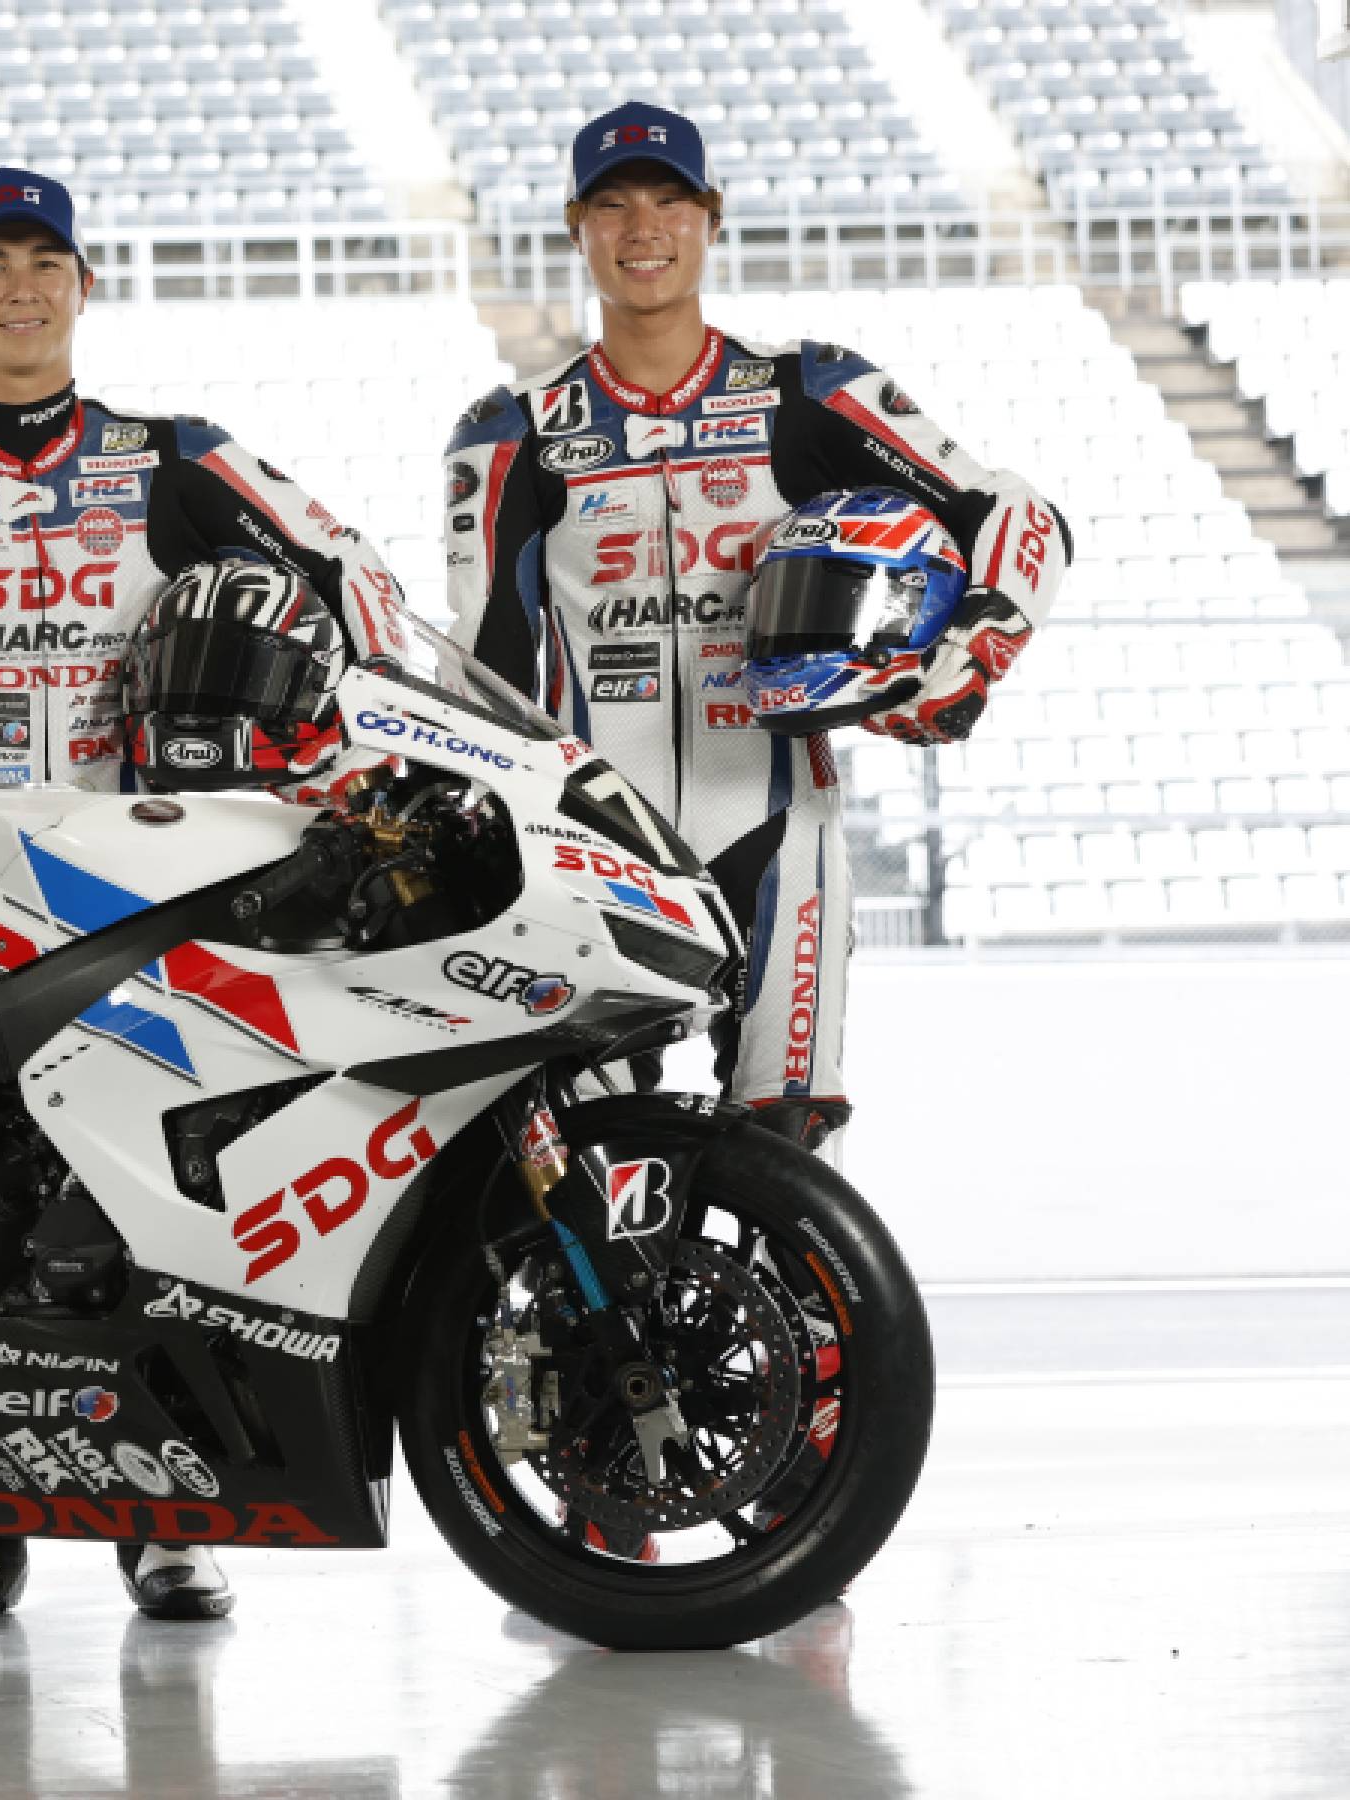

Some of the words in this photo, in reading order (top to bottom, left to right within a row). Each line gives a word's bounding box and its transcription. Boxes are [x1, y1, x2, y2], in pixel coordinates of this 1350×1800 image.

[709, 395, 776, 409] HONDA
[544, 437, 611, 471] Arai
[699, 417, 761, 440] HRC
[75, 477, 135, 499] HRC
[86, 456, 153, 470] HONDA
[590, 521, 760, 584] SDG
[778, 519, 836, 545] Arai
[1016, 500, 1054, 593] SDG
[594, 679, 635, 697] elf
[166, 740, 218, 766] Arai
[553, 844, 658, 894] SDG
[442, 950, 538, 1004] elf
[784, 893, 819, 1084] HONDA
[233, 1096, 439, 1286] SDG
[196, 1304, 342, 1363] SHOWA
[3, 1427, 75, 1488] RK
[57, 1426, 124, 1489] NGK
[163, 1441, 218, 1495] Arai
